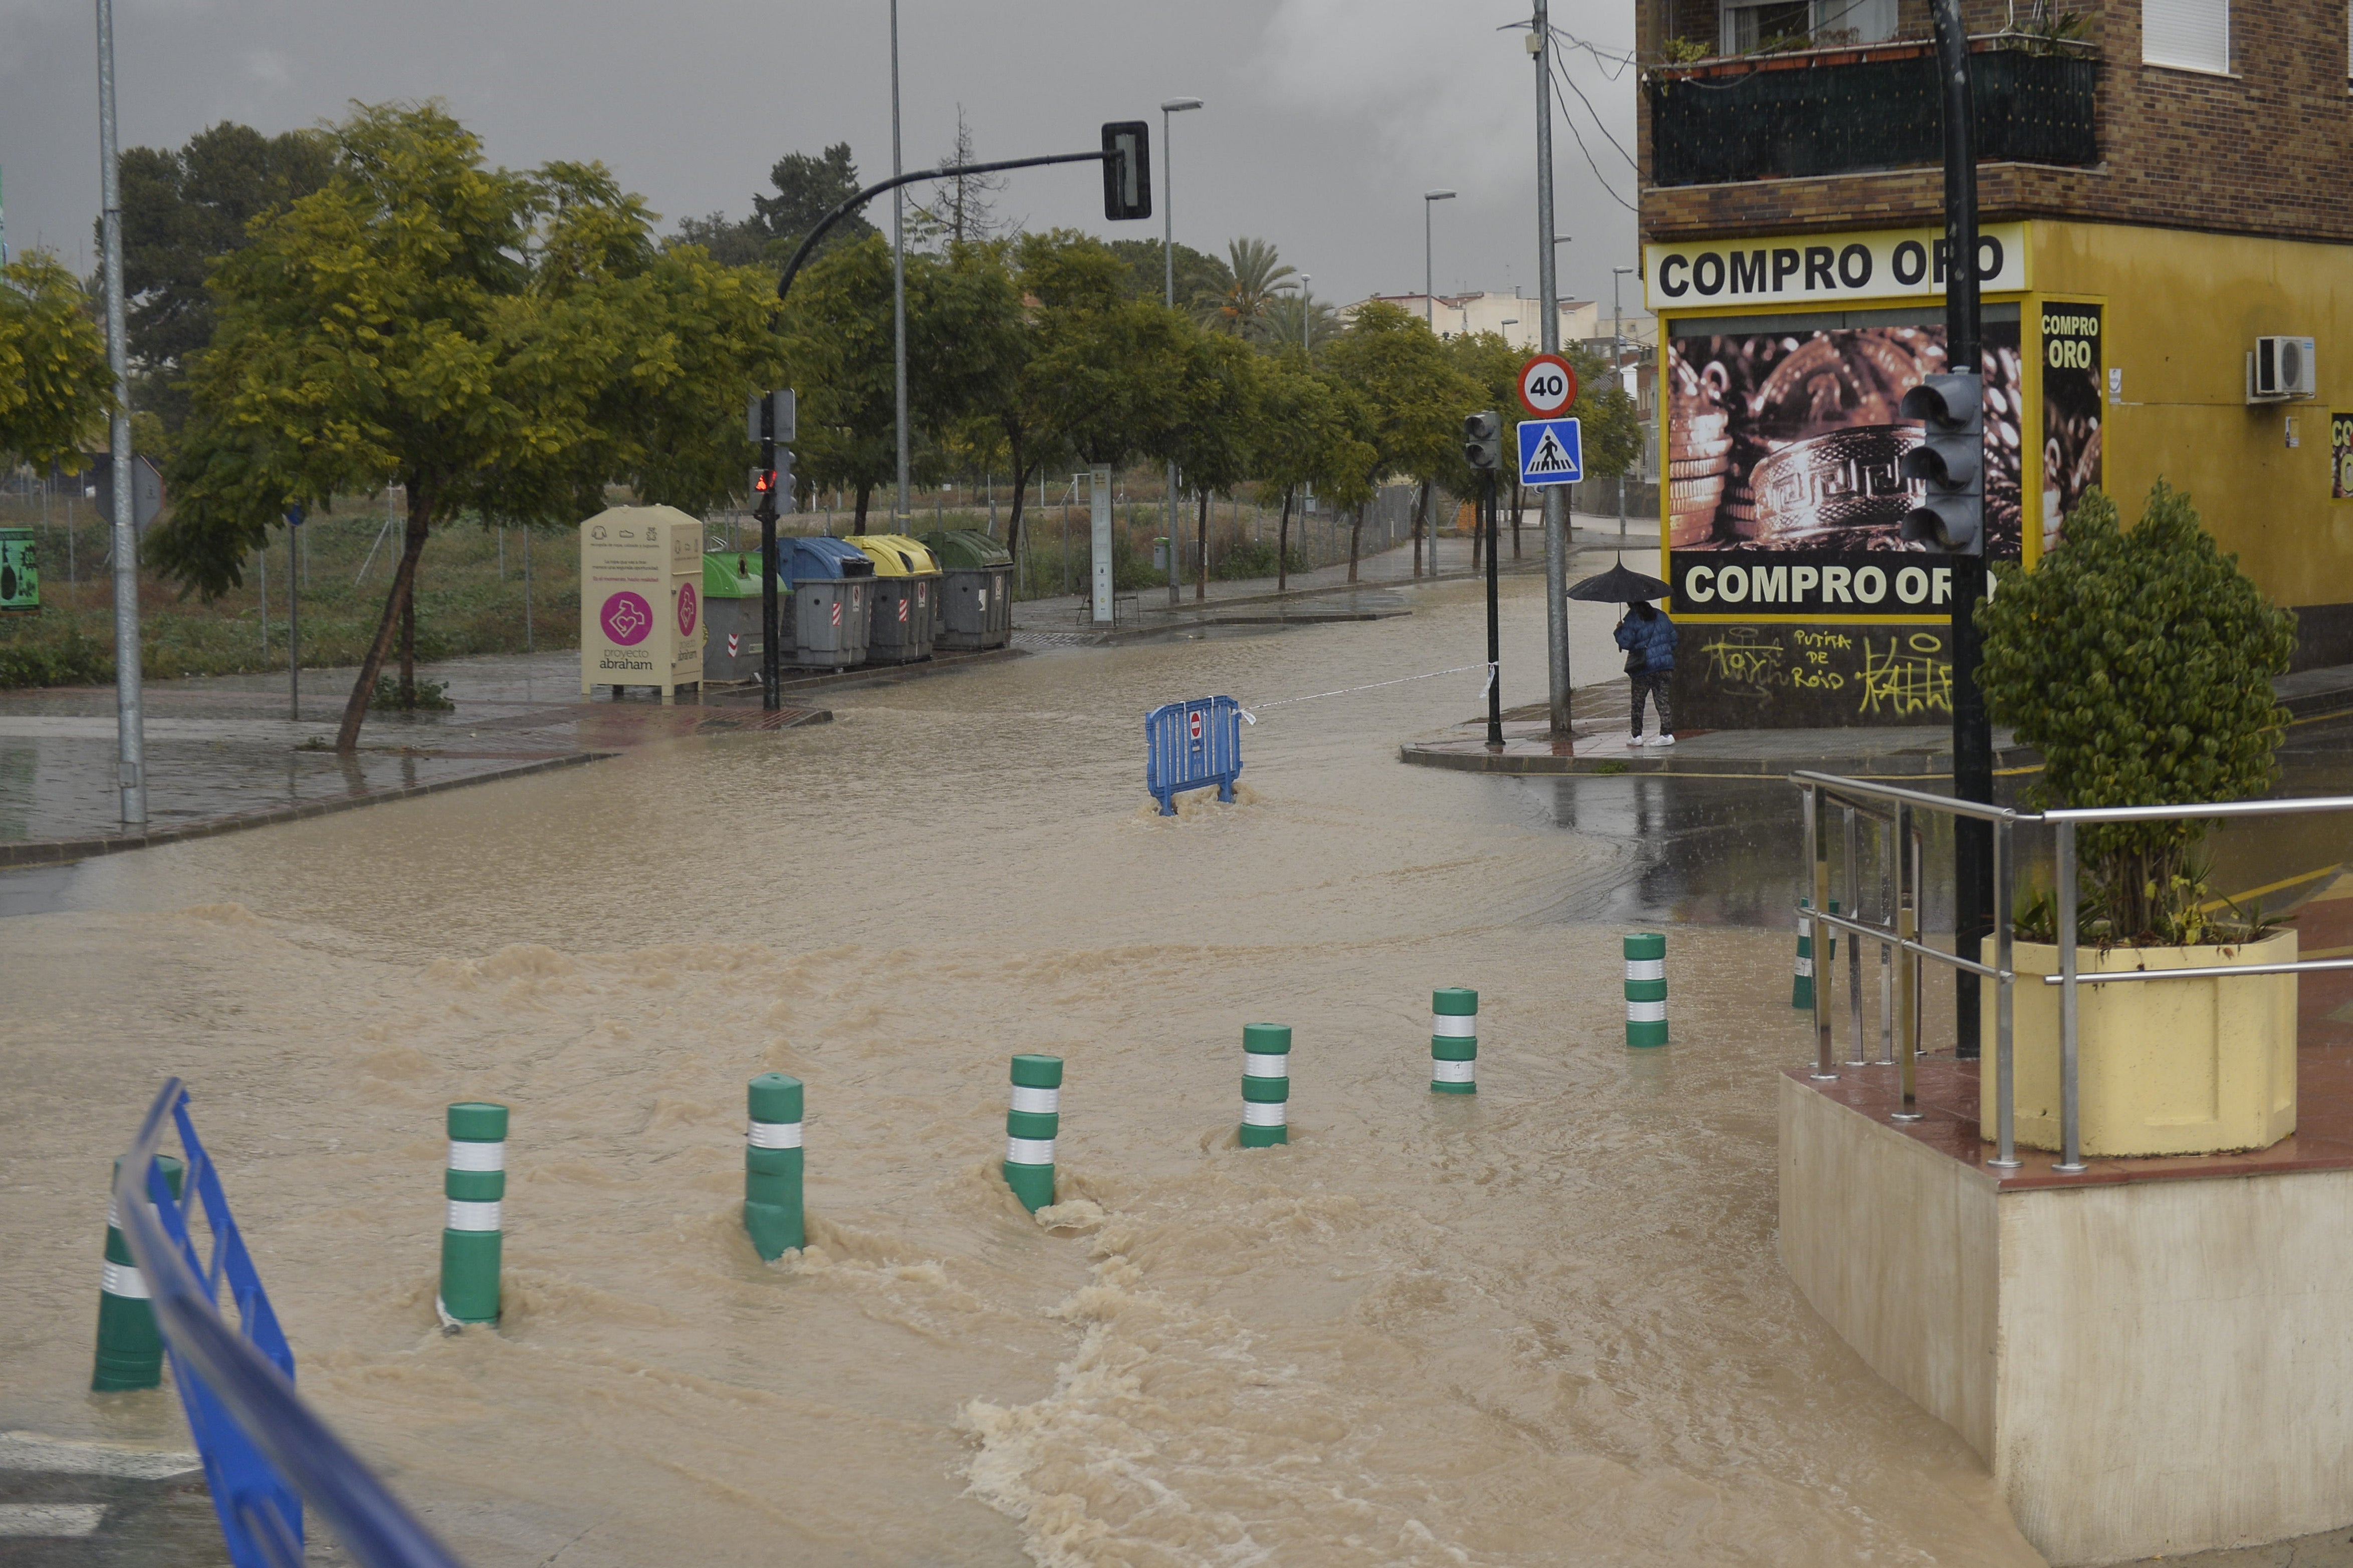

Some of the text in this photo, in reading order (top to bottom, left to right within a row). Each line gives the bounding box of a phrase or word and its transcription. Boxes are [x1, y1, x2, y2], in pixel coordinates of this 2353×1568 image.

[1659, 243, 1873, 297] COMPRO
[2042, 315, 2098, 336] COMPRO
[2049, 339, 2091, 369] ORO
[1530, 375, 1563, 396] 40
[1685, 565, 1887, 604] COMPRO
[599, 658, 653, 670] abraham
[604, 649, 649, 660] proyecto
[1806, 651, 1829, 664] DE
